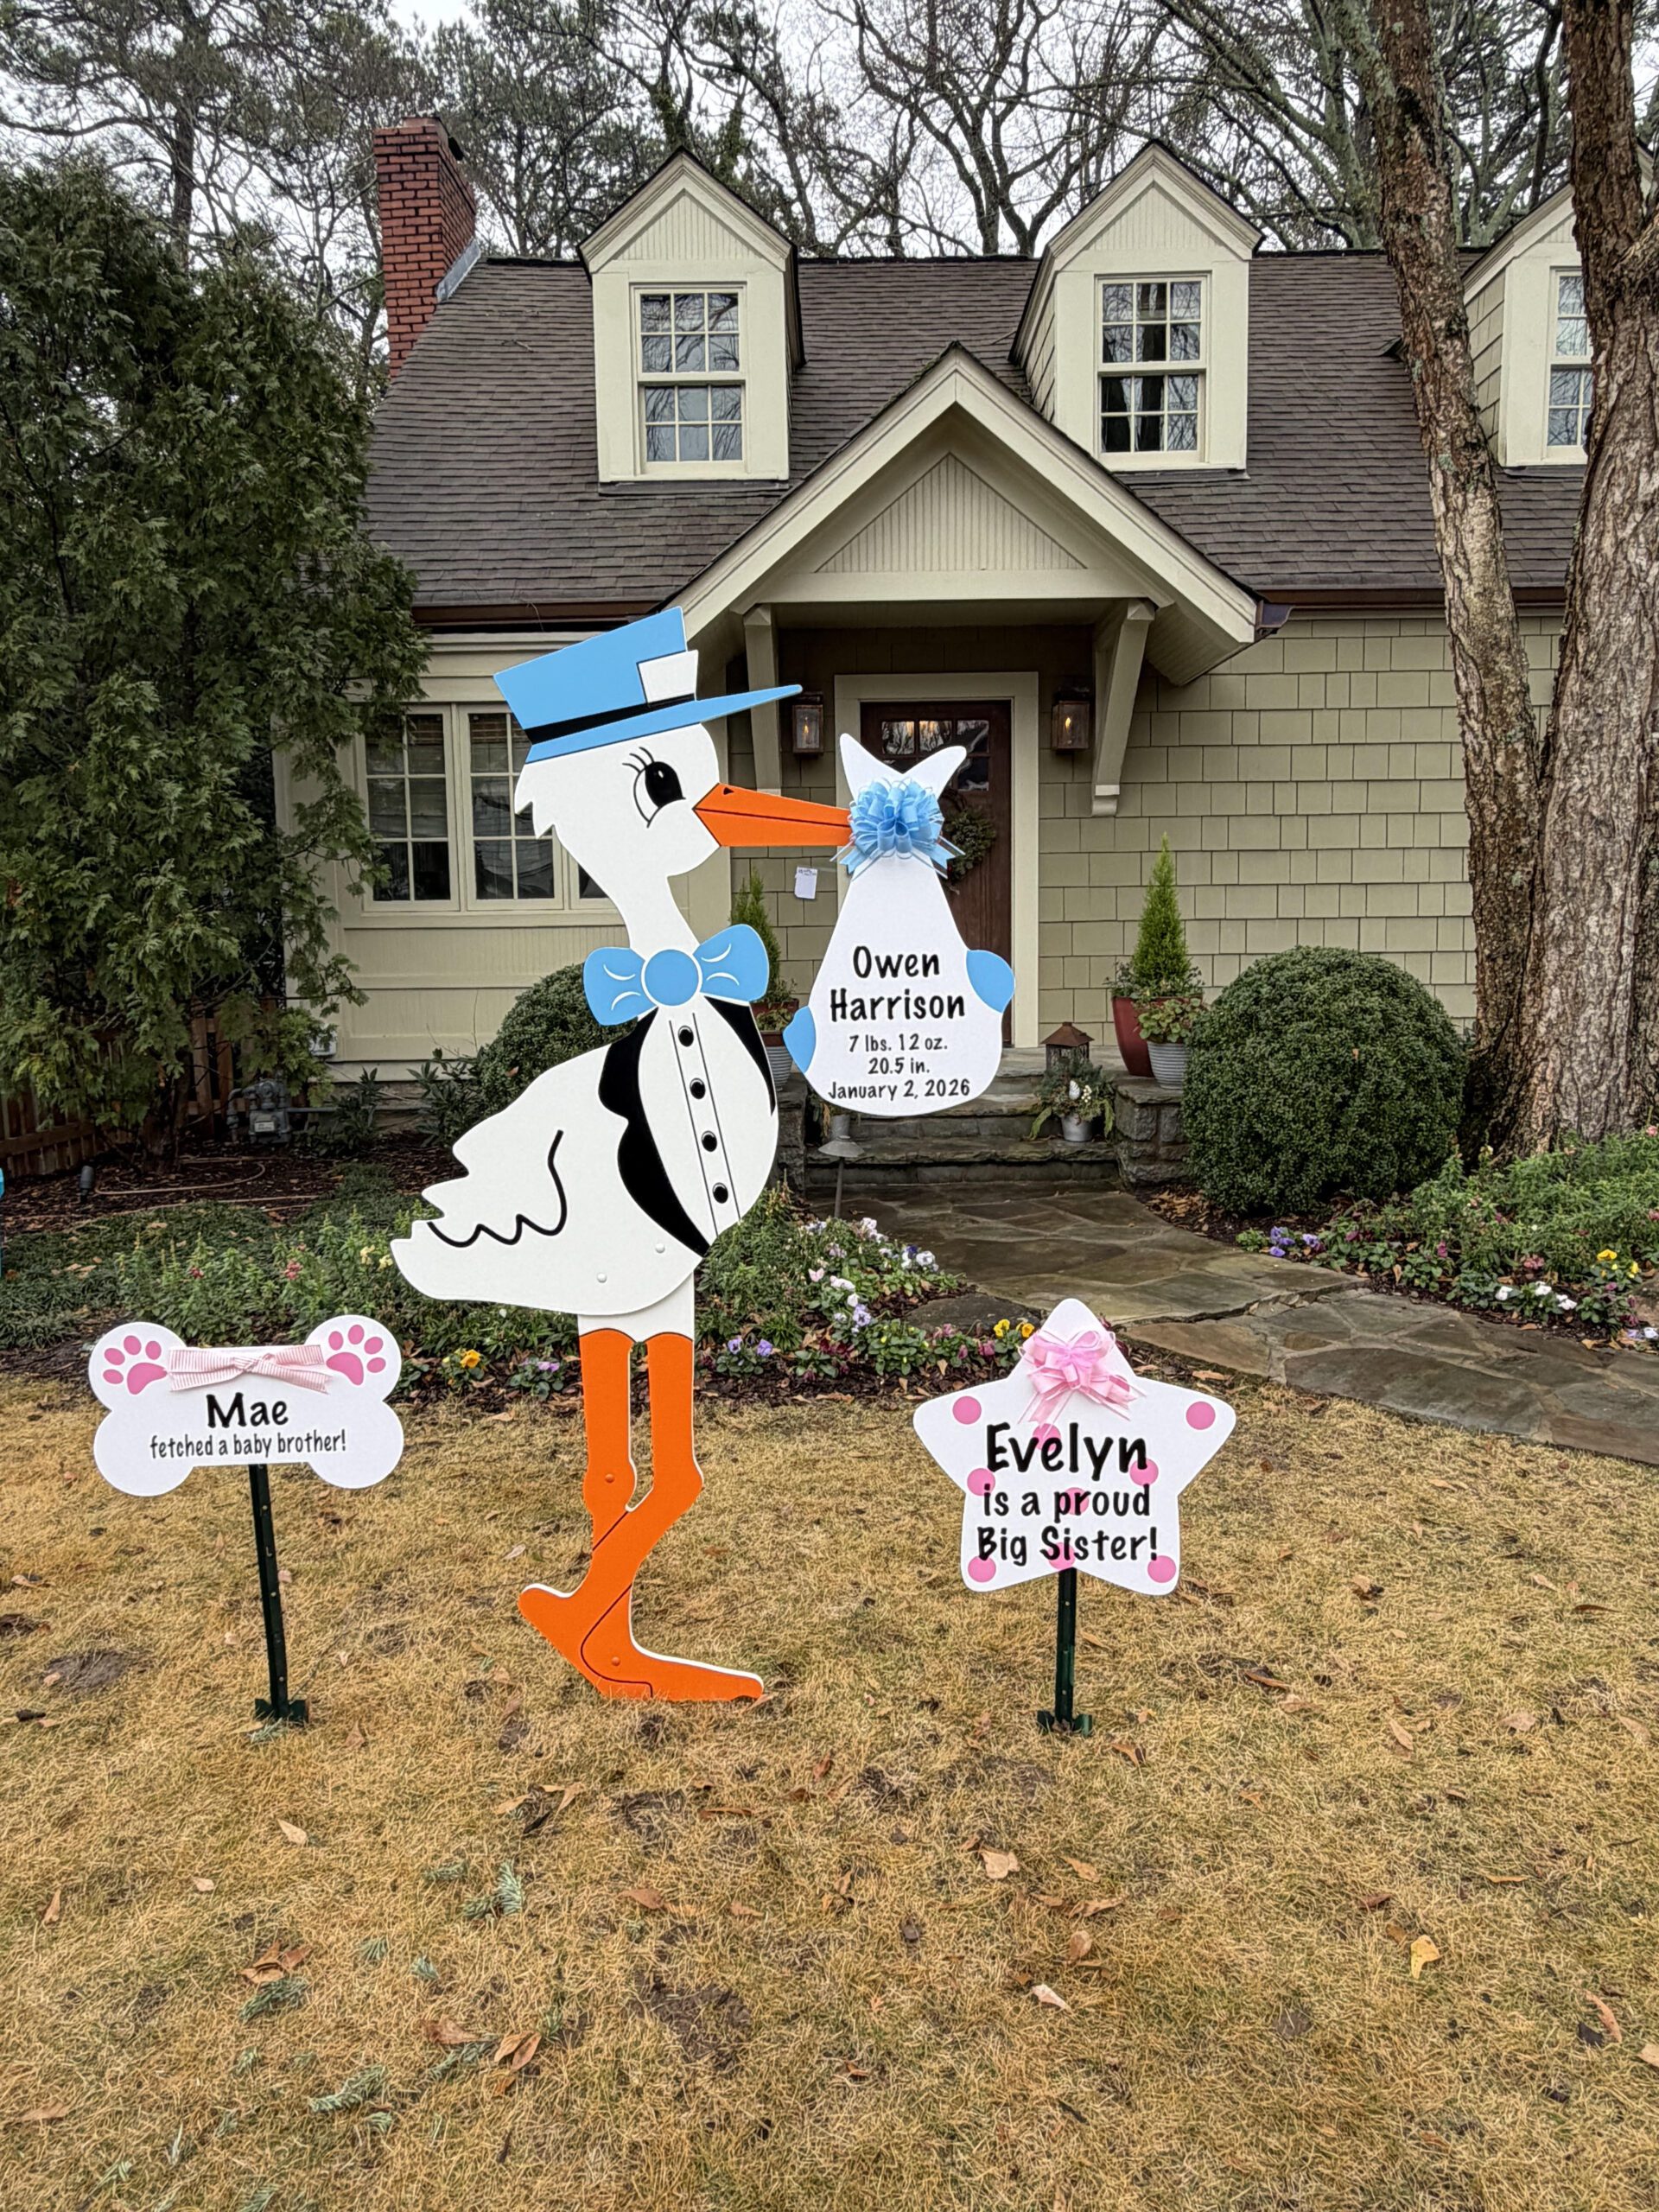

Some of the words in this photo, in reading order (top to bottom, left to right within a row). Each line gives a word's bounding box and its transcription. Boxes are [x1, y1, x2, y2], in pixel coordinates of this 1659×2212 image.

[853, 946, 939, 977] Owen
[830, 988, 964, 1021] Harrison
[849, 1035, 859, 1052] 7
[865, 1035, 892, 1052] lbs.
[899, 1033, 919, 1051] 12
[925, 1039, 947, 1050] oz.
[868, 1058, 904, 1074] 20.5
[911, 1058, 930, 1073] in.
[829, 1082, 897, 1101] January
[903, 1080, 918, 1098] 2,
[925, 1079, 969, 1096] 2026
[207, 1393, 289, 1428] Mae
[150, 1434, 213, 1459] fetched
[219, 1441, 228, 1455] a
[234, 1434, 272, 1457] baby
[278, 1429, 346, 1452] brother!
[987, 1422, 1147, 1481] Evelyn
[983, 1484, 1009, 1516] is
[1021, 1492, 1039, 1516] a
[1054, 1484, 1150, 1522] proud
[977, 1527, 1027, 1566] Big
[1039, 1526, 1157, 1560] Sister!
